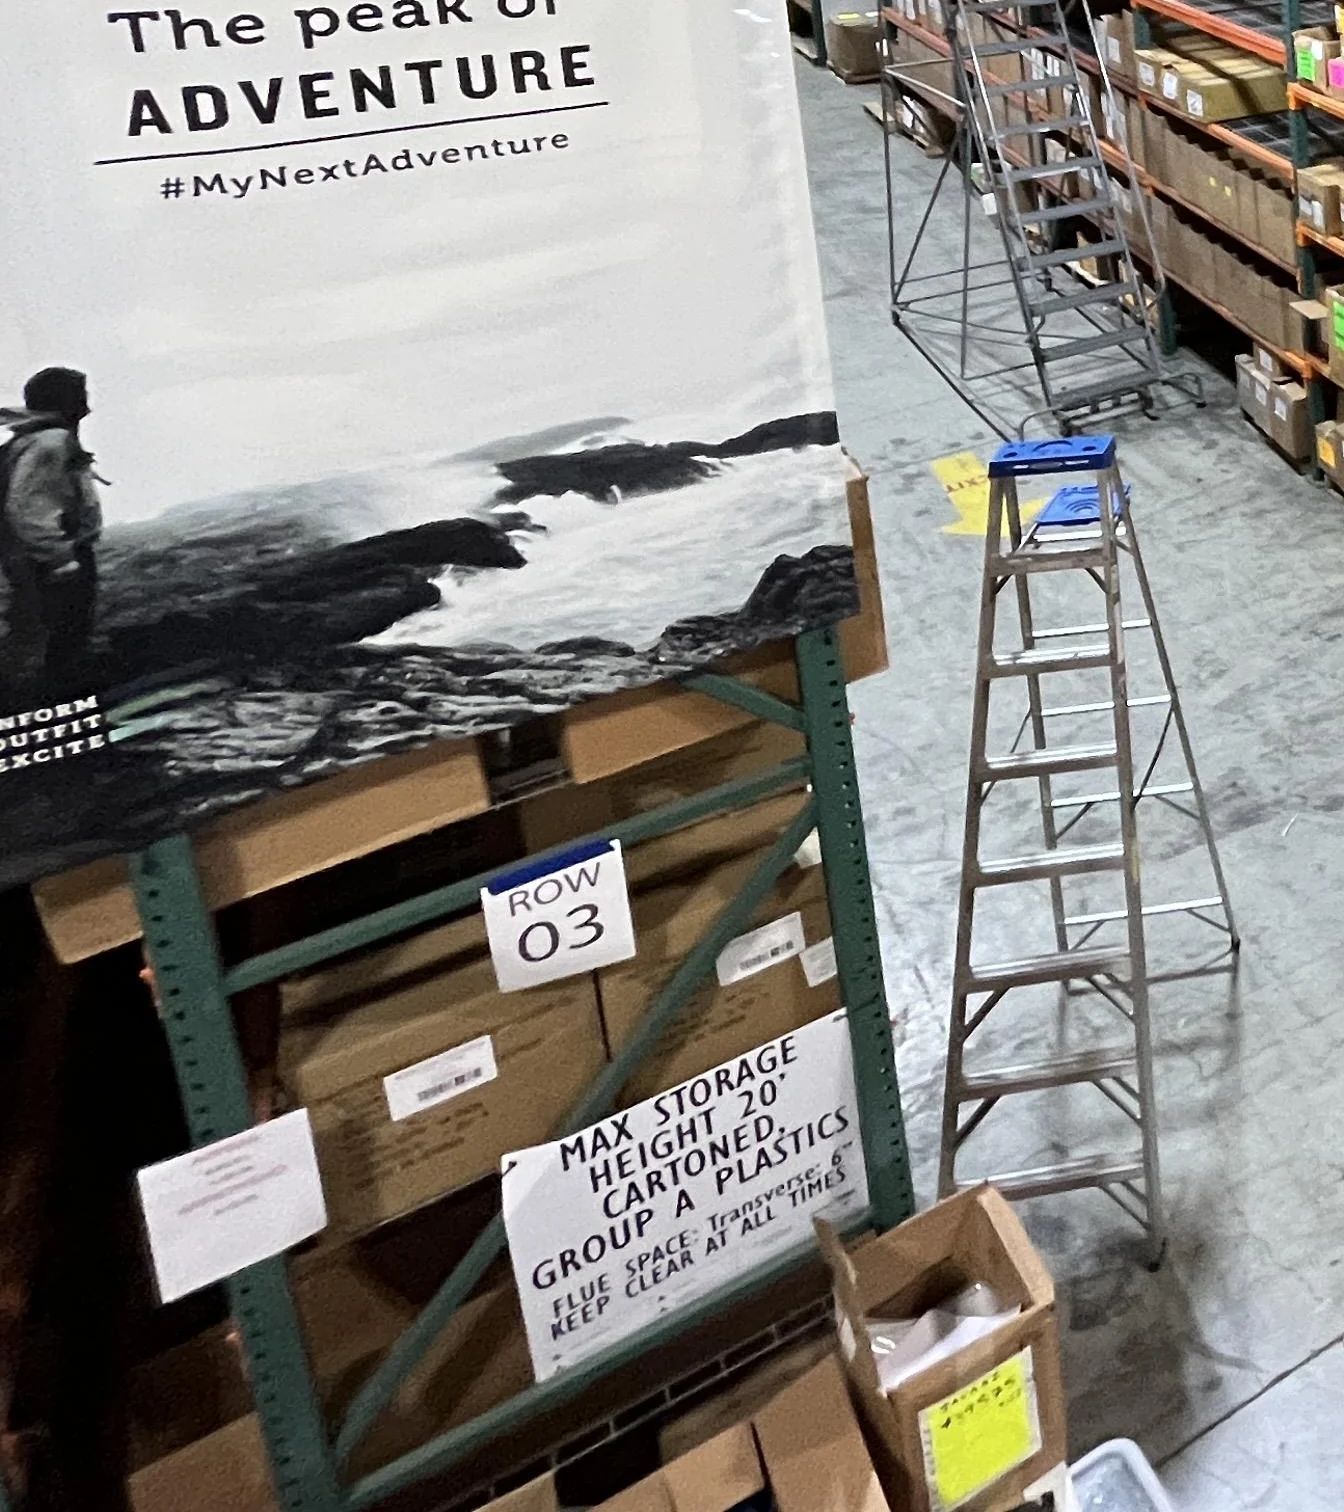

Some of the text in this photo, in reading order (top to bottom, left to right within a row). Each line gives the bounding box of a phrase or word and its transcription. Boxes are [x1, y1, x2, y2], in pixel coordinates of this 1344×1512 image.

[107, 9, 266, 55] The
[126, 45, 597, 138] ADVENTURE
[160, 128, 570, 200] #MyNextAdventure
[0, 695, 98, 730] NFORM
[509, 862, 600, 917] ROW
[518, 903, 604, 962] 03
[561, 1036, 799, 1173] MAX STORAGE
[590, 1106, 714, 1193] HEIGHT
[532, 1106, 850, 1291] GROUP A PLASTICS
[550, 1166, 846, 1341] KEEP CLEAR AT ALL TIMES
[553, 1273, 610, 1320] FLUE
